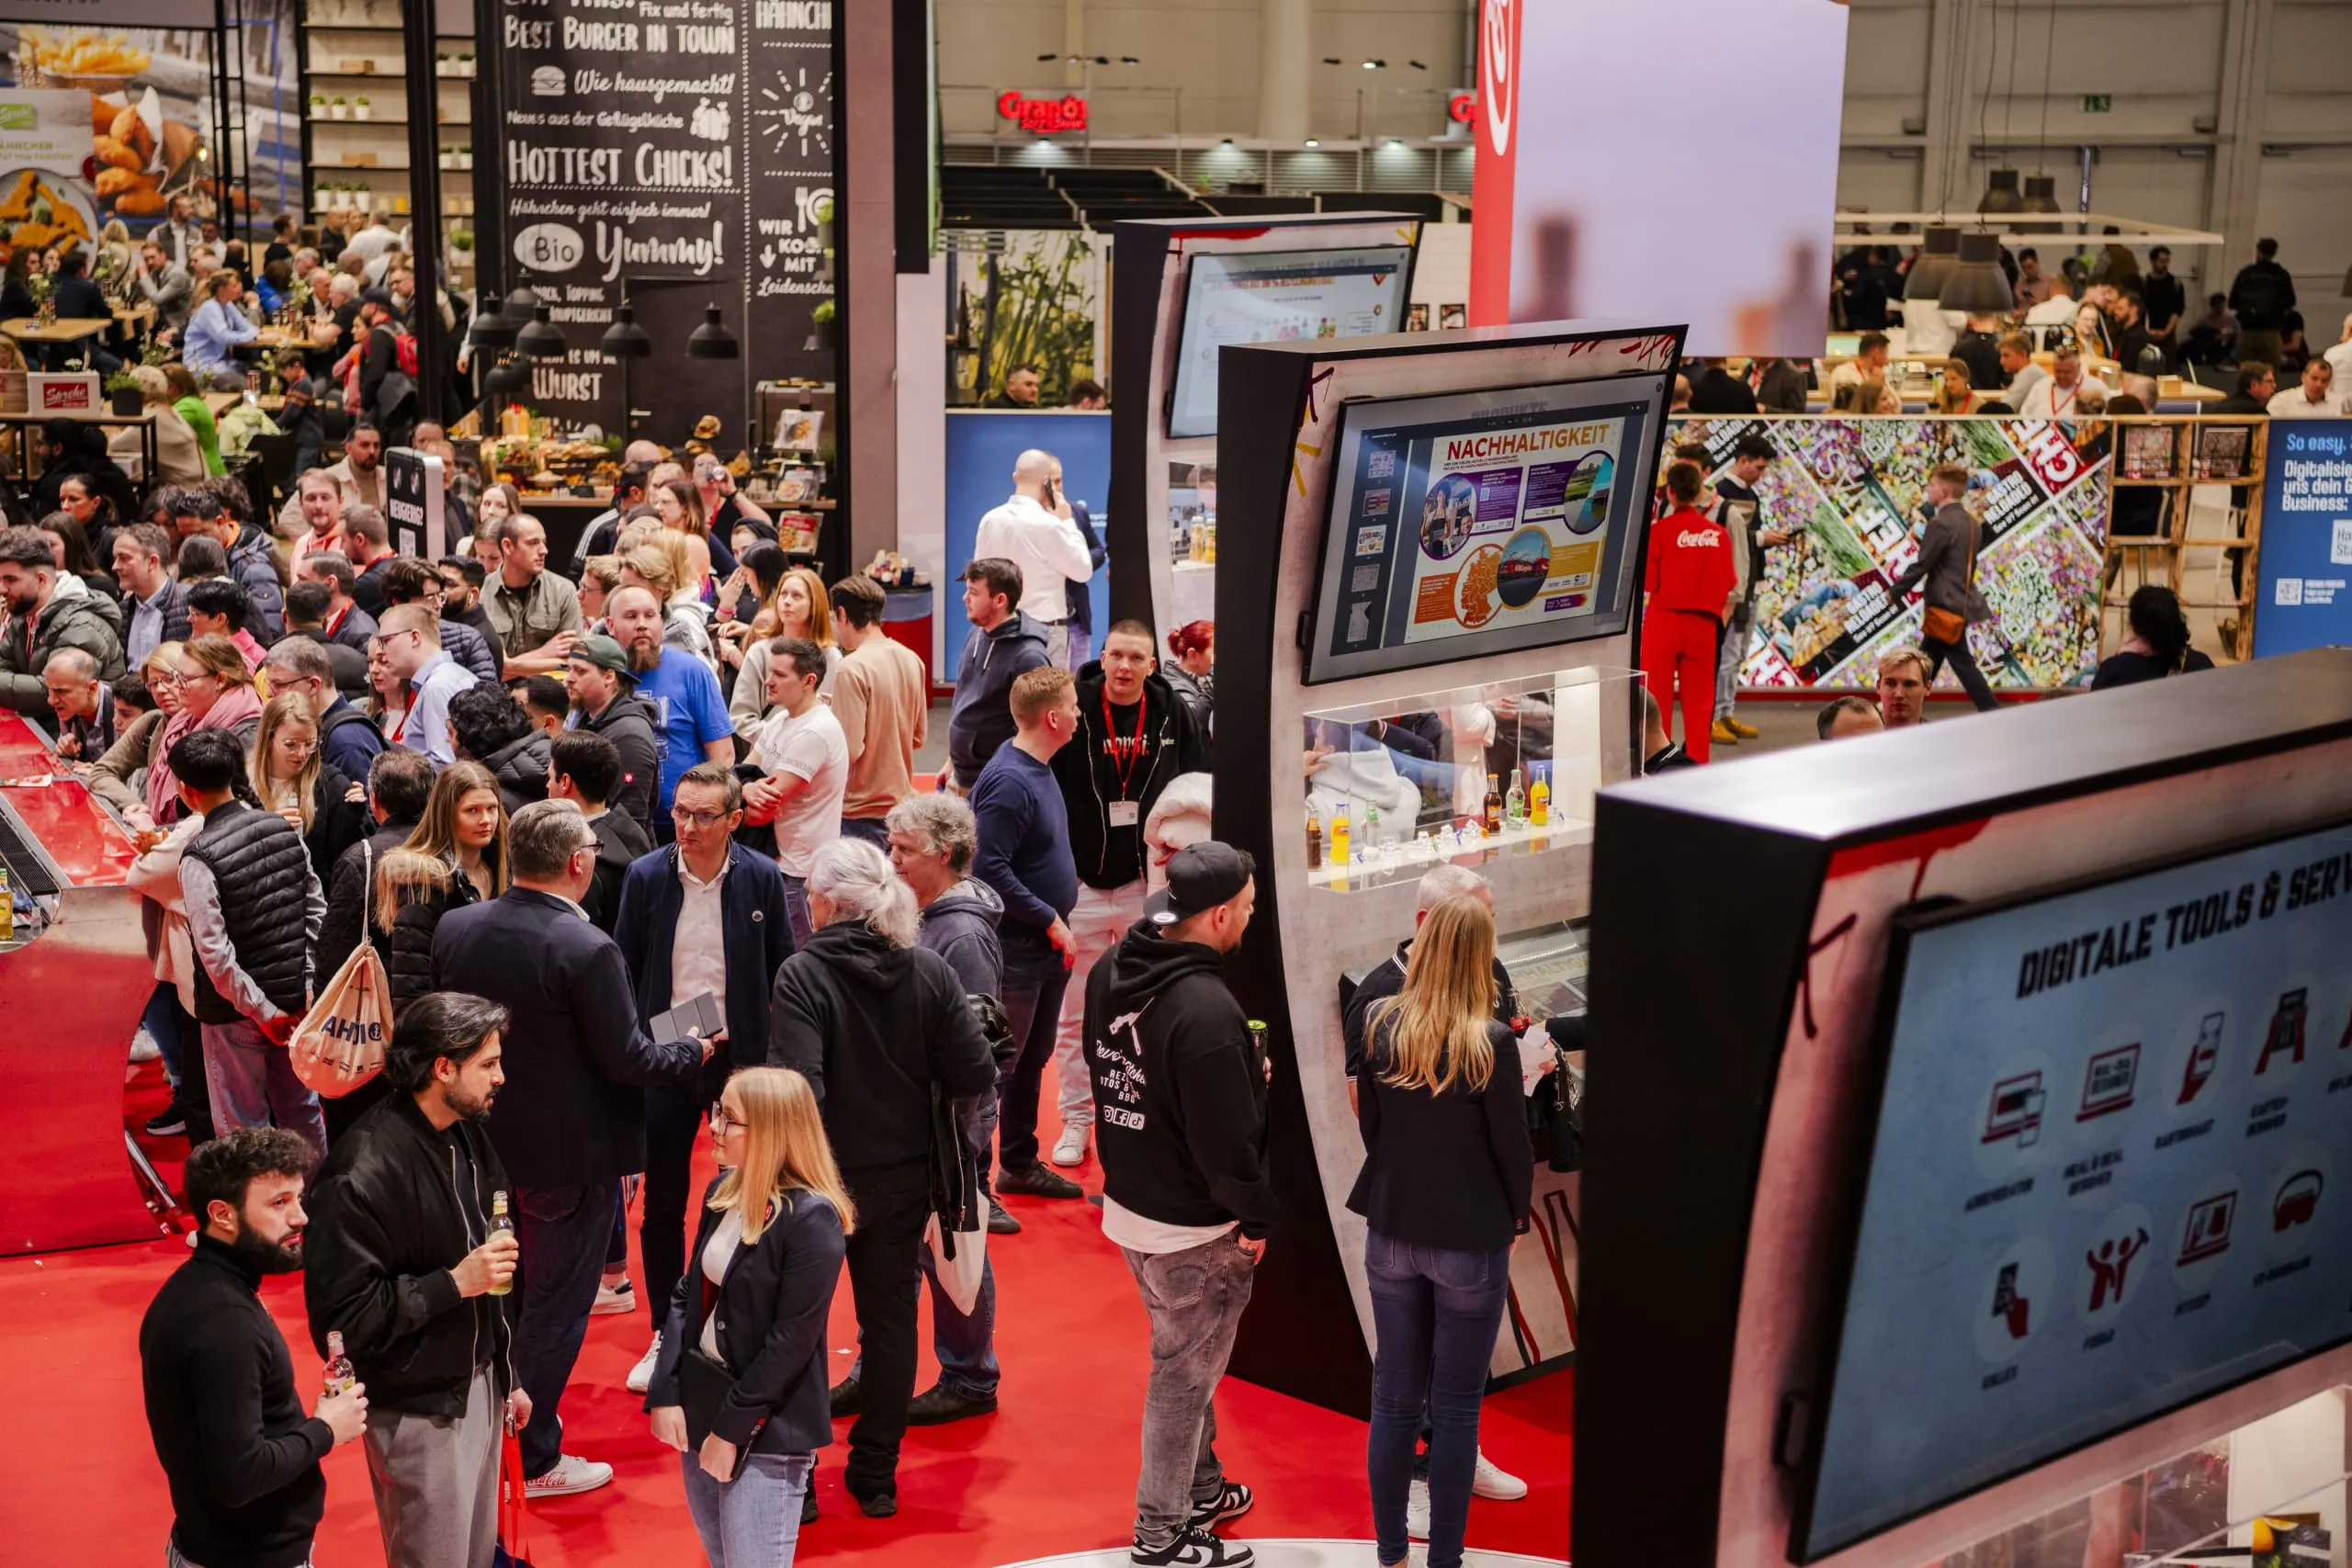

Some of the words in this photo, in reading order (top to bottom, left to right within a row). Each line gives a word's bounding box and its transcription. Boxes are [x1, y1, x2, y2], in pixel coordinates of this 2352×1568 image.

[663, 3, 689, 18] und
[691, 3, 734, 26] fertig
[504, 14, 555, 50] BEST
[563, 16, 639, 51] BURGER
[647, 24, 669, 53] IN
[675, 25, 736, 55] TOWN
[574, 69, 614, 95] Wie
[615, 71, 736, 104] hausgemacht!
[507, 110, 546, 127] Neues
[548, 113, 571, 126] aus
[572, 110, 595, 126] der
[508, 140, 623, 186] HOTTEST
[635, 142, 733, 188] CHICKS!
[510, 197, 577, 217] Hähnchen
[578, 201, 610, 223] geht
[610, 200, 661, 224] einfach
[662, 201, 712, 219] immer!
[758, 219, 794, 235] WIR
[534, 236, 575, 263] Bio
[596, 220, 724, 283] Yummy!
[784, 257, 817, 273] MIT
[568, 349, 581, 365] ES
[583, 349, 600, 365] UM
[533, 367, 603, 401] WURST
[1447, 423, 1610, 460] NACHHALTIGKEIT
[2287, 433, 2305, 452] So
[2308, 435, 2346, 456] easy.
[2283, 479, 2309, 495] uns
[2312, 478, 2342, 495] dein
[2282, 494, 2348, 512] Business:
[1844, 591, 1889, 635] RELOADE
[2016, 913, 2158, 1000] DIGITALE
[2165, 882, 2255, 952] TOOLS
[2258, 870, 2282, 920] &
